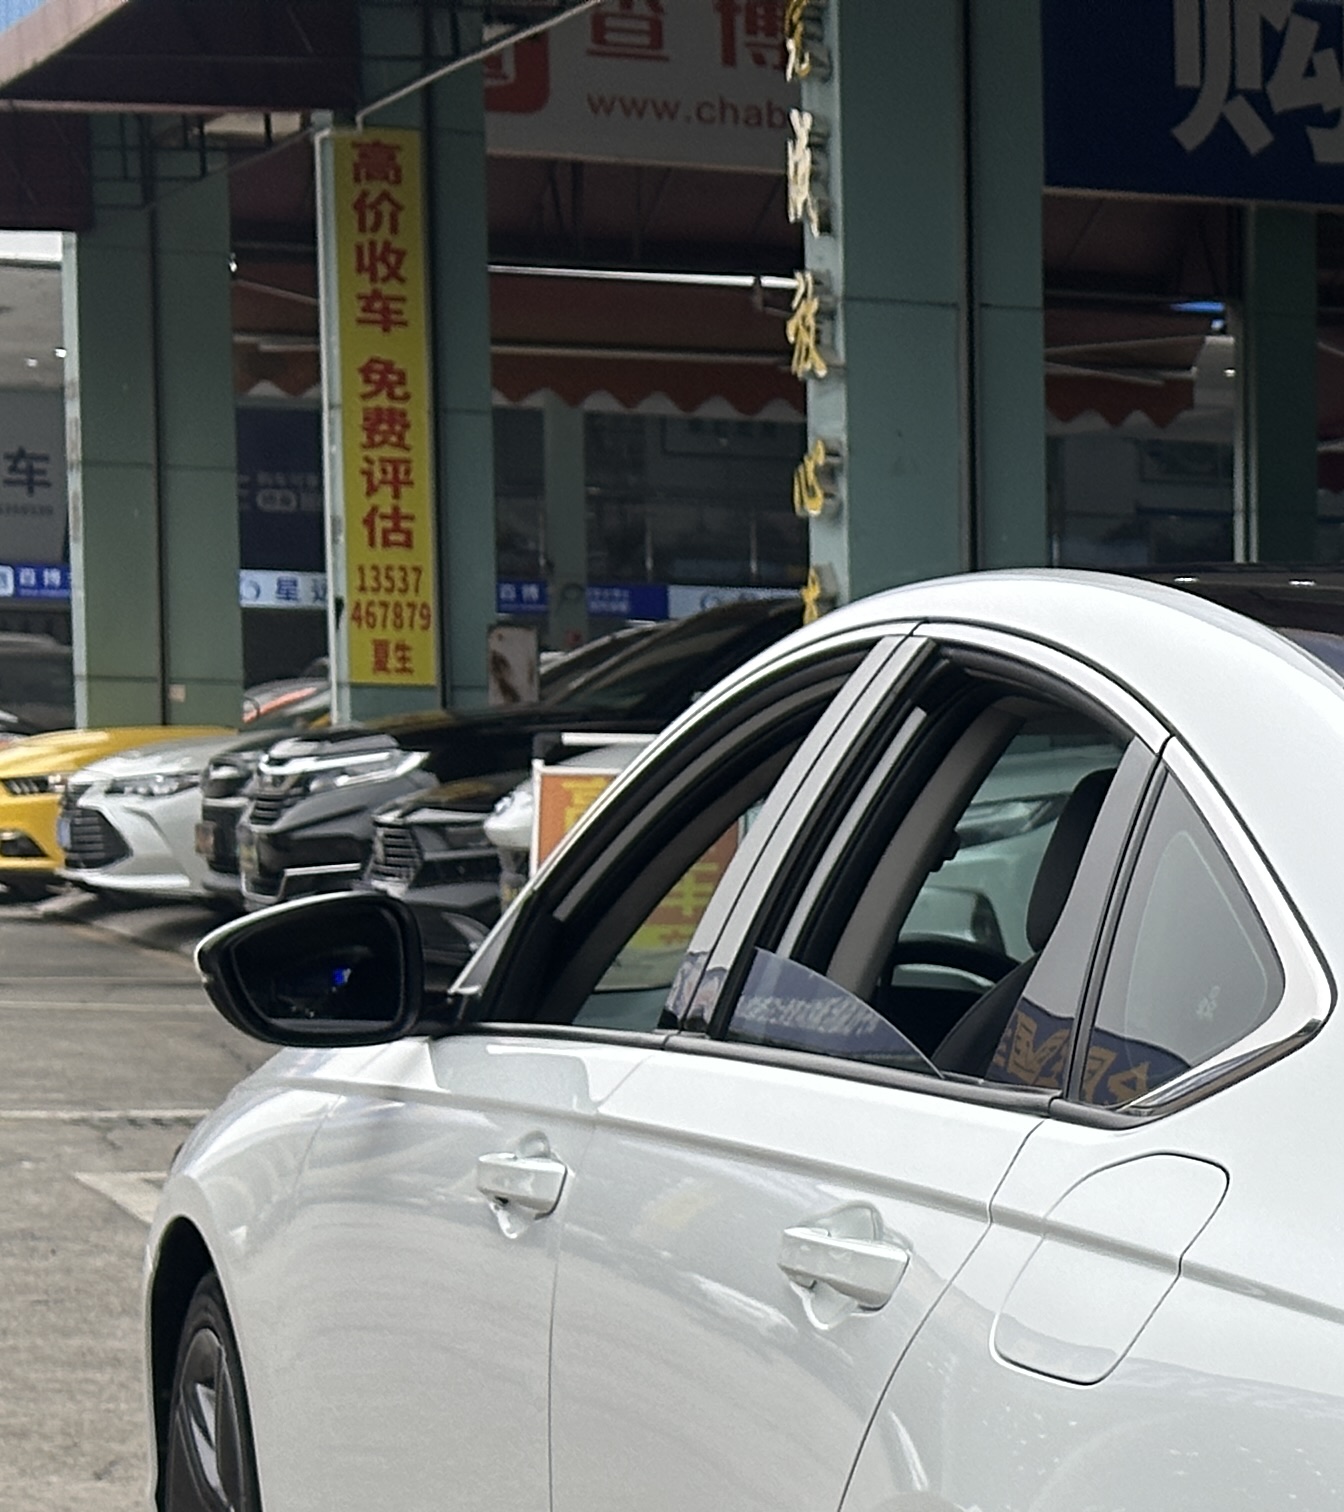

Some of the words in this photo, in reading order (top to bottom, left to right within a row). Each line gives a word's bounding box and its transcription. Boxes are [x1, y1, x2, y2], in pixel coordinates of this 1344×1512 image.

[349, 139, 411, 334] 高价收车
[356, 356, 417, 551] 免费评估
[356, 564, 425, 594] 13537
[350, 600, 433, 632] 467879
[371, 638, 415, 676] 夏生
